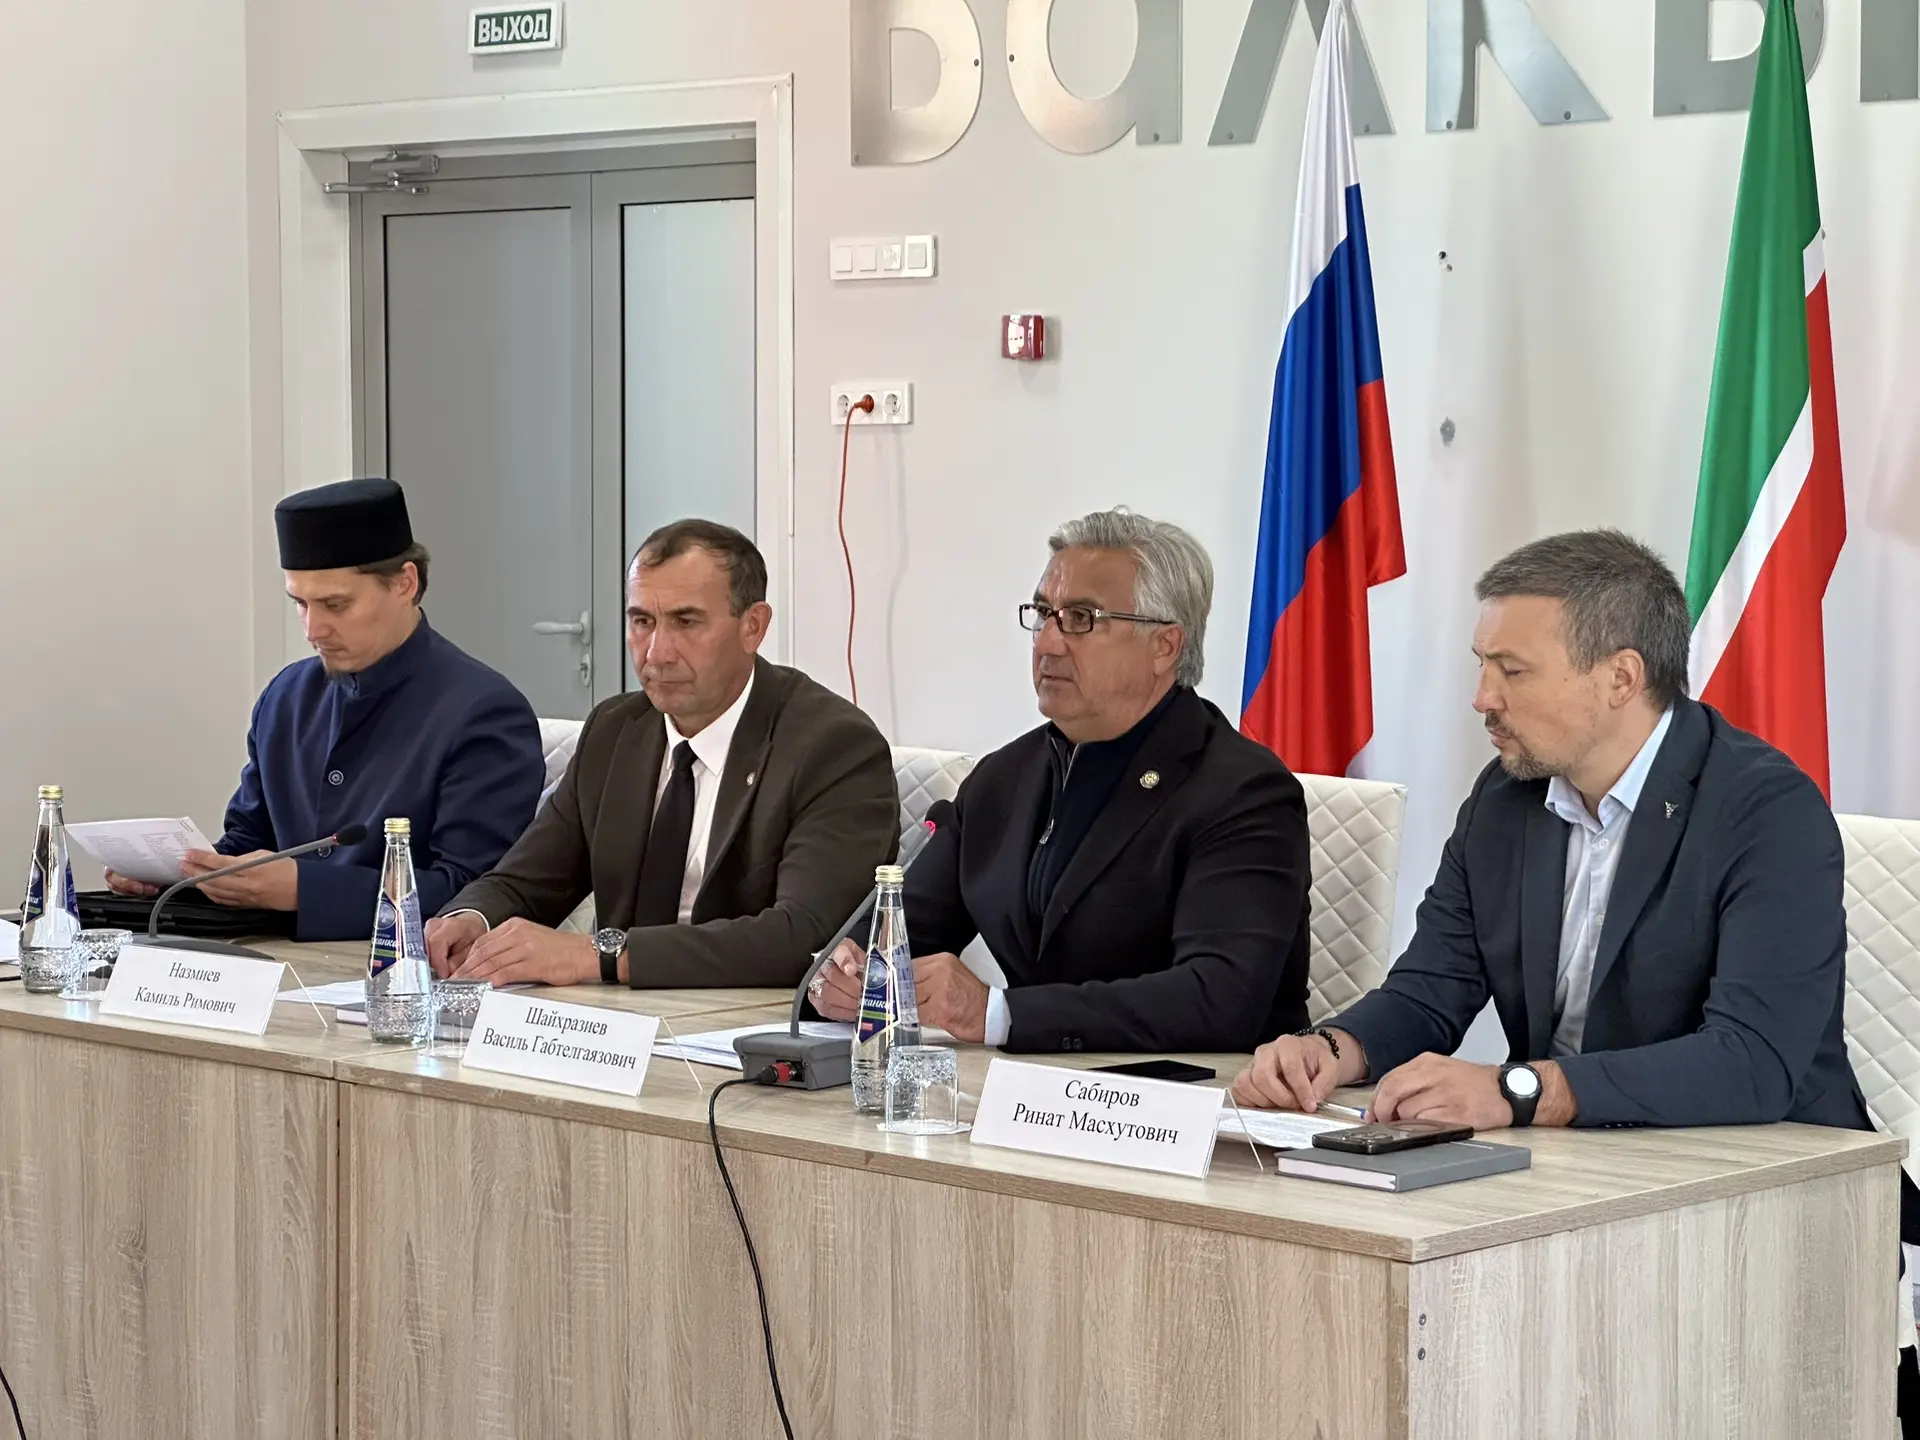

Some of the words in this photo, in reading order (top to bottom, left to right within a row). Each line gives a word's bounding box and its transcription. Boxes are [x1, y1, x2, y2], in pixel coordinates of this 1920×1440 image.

[478, 13, 548, 44] ВЫХОД
[169, 962, 221, 982] Назмиев
[135, 986, 180, 1007] Камиль
[183, 992, 236, 1013] Римович
[525, 1006, 608, 1036] Шайхразиев
[483, 1027, 529, 1051] Василь
[531, 1035, 637, 1069] Габтелгаязович
[1065, 1080, 1140, 1109] Сабиров
[1012, 1103, 1065, 1128] Ринат
[1068, 1111, 1179, 1144] Масхутович
